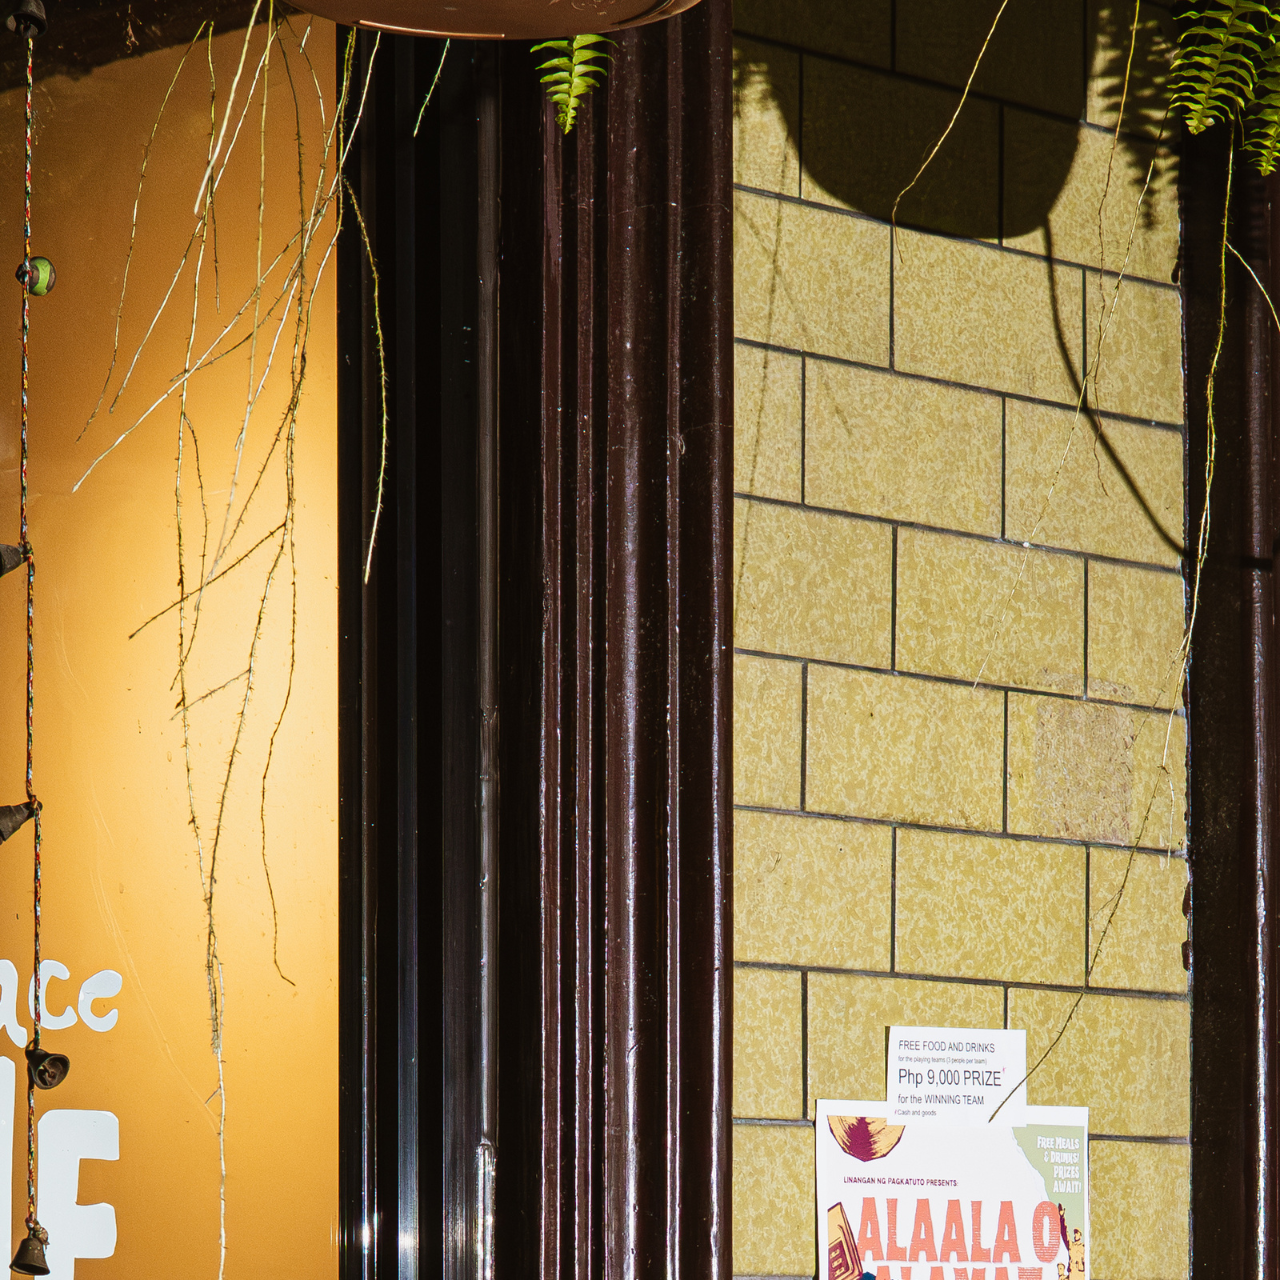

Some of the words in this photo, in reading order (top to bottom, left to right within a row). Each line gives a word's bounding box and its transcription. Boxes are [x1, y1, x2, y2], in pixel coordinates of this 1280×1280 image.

[898, 1040, 920, 1051] FREE
[923, 1041, 946, 1052] FOOD
[948, 1042, 964, 1052] AND
[966, 1042, 995, 1053] DRINKS
[914, 1056, 930, 1064] playing
[932, 1056, 946, 1064] teams
[898, 1068, 923, 1088] Php
[927, 1070, 960, 1088] 9,000
[898, 1094, 908, 1104] for
[910, 1094, 922, 1104] the
[924, 1094, 960, 1104] WINNING
[963, 1095, 984, 1105] TEAM
[922, 1110, 936, 1118] goods
[1037, 1136, 1054, 1150] FREE
[1055, 1136, 1080, 1150] MEALS
[1044, 1150, 1050, 1162] &
[1050, 1150, 1080, 1164] DRINKS!
[1054, 1166, 1080, 1180] PRIZES
[844, 1176, 876, 1184] LINANGAN
[876, 1177, 886, 1185] NG
[888, 1178, 925, 1186] PAGKATUTO
[926, 1178, 958, 1187] PRESENTS:
[1053, 1180, 1082, 1193] AWAIT!
[857, 1196, 1022, 1263] ALAALA
[1032, 1200, 1061, 1263] O
